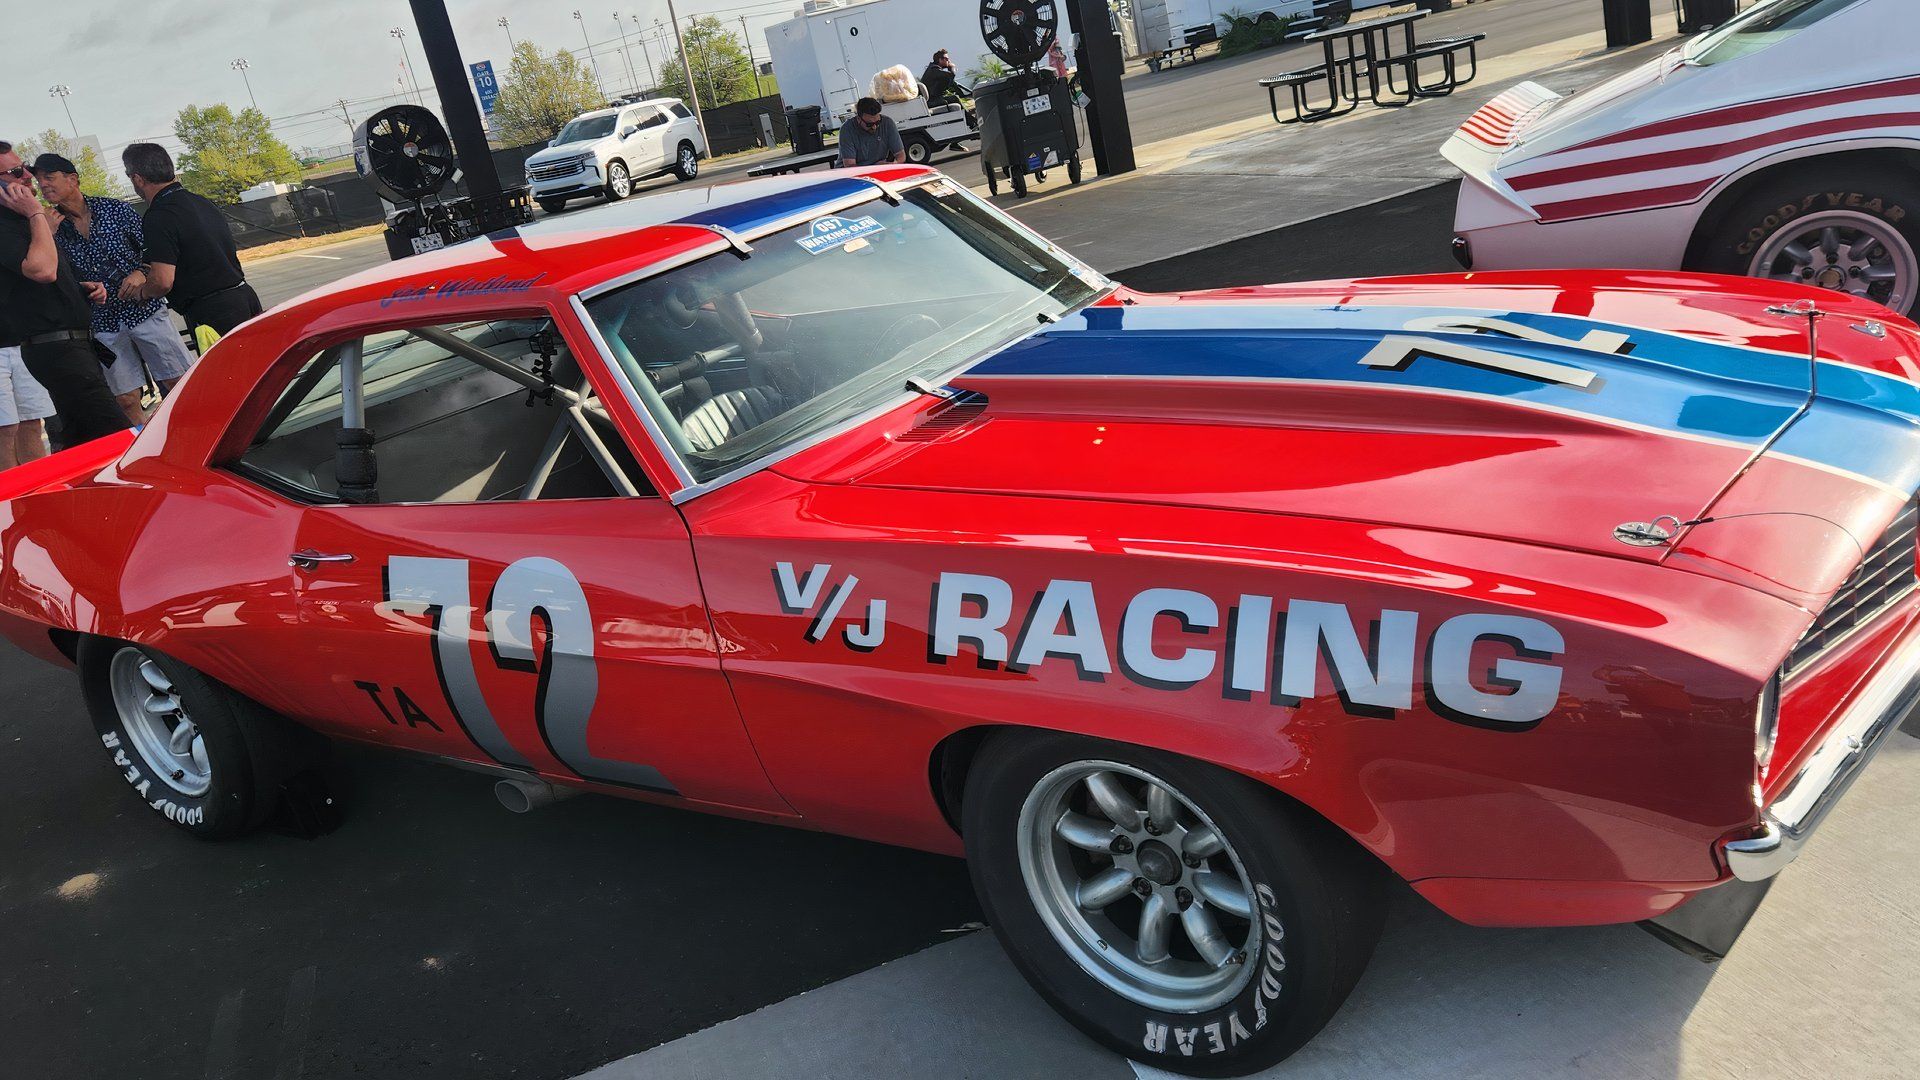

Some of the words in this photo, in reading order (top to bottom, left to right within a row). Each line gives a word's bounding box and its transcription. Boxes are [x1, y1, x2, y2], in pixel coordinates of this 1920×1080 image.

[478, 76, 492, 88] 10
[815, 218, 843, 232] 057
[848, 218, 878, 232] GLEN
[1357, 315, 1637, 395] 72
[770, 561, 888, 654] V/J
[926, 571, 1566, 734] RACING
[381, 555, 681, 797] 72
[353, 680, 444, 733] TA
